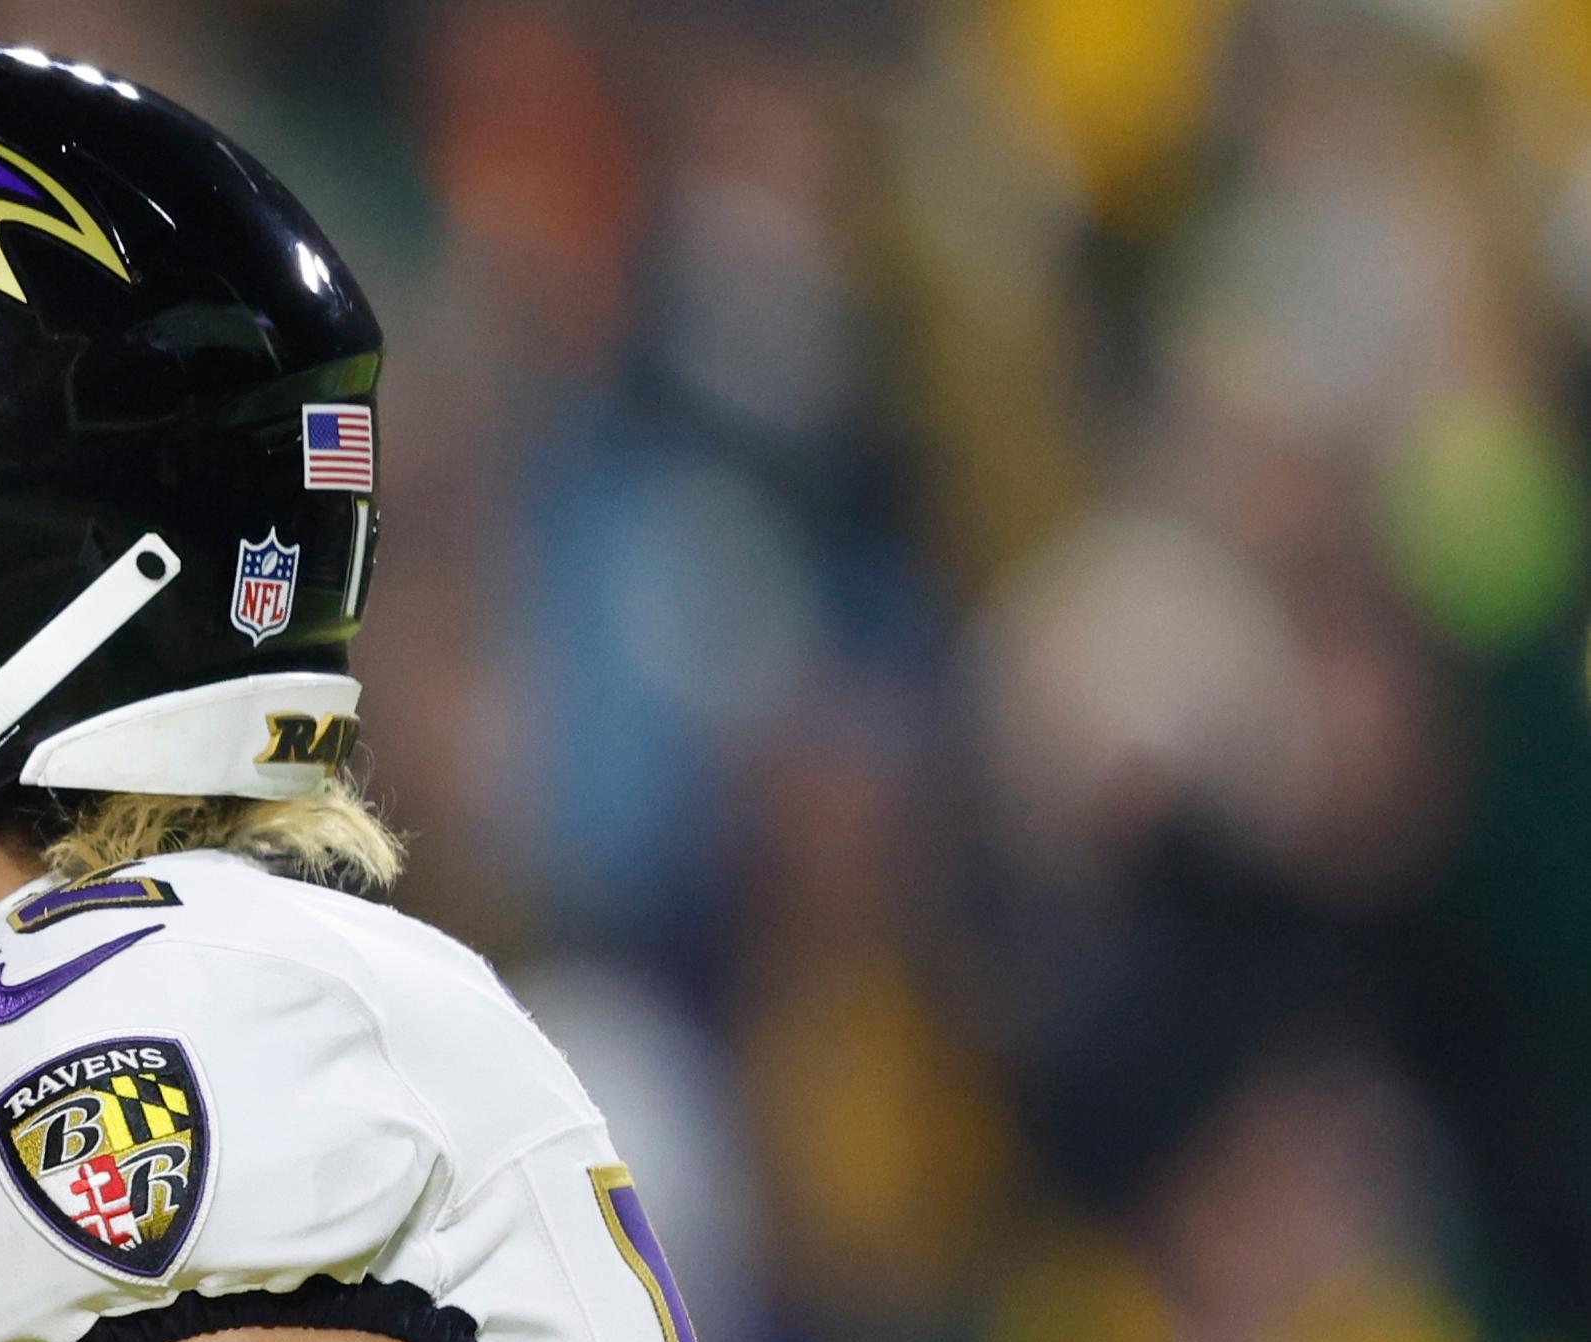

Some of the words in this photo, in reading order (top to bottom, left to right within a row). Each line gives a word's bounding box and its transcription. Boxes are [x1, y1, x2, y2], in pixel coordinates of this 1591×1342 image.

[240, 580, 285, 626] NFL
[3, 1047, 168, 1120] RAVENS
[14, 1094, 105, 1175] B
[117, 1142, 192, 1224] R
